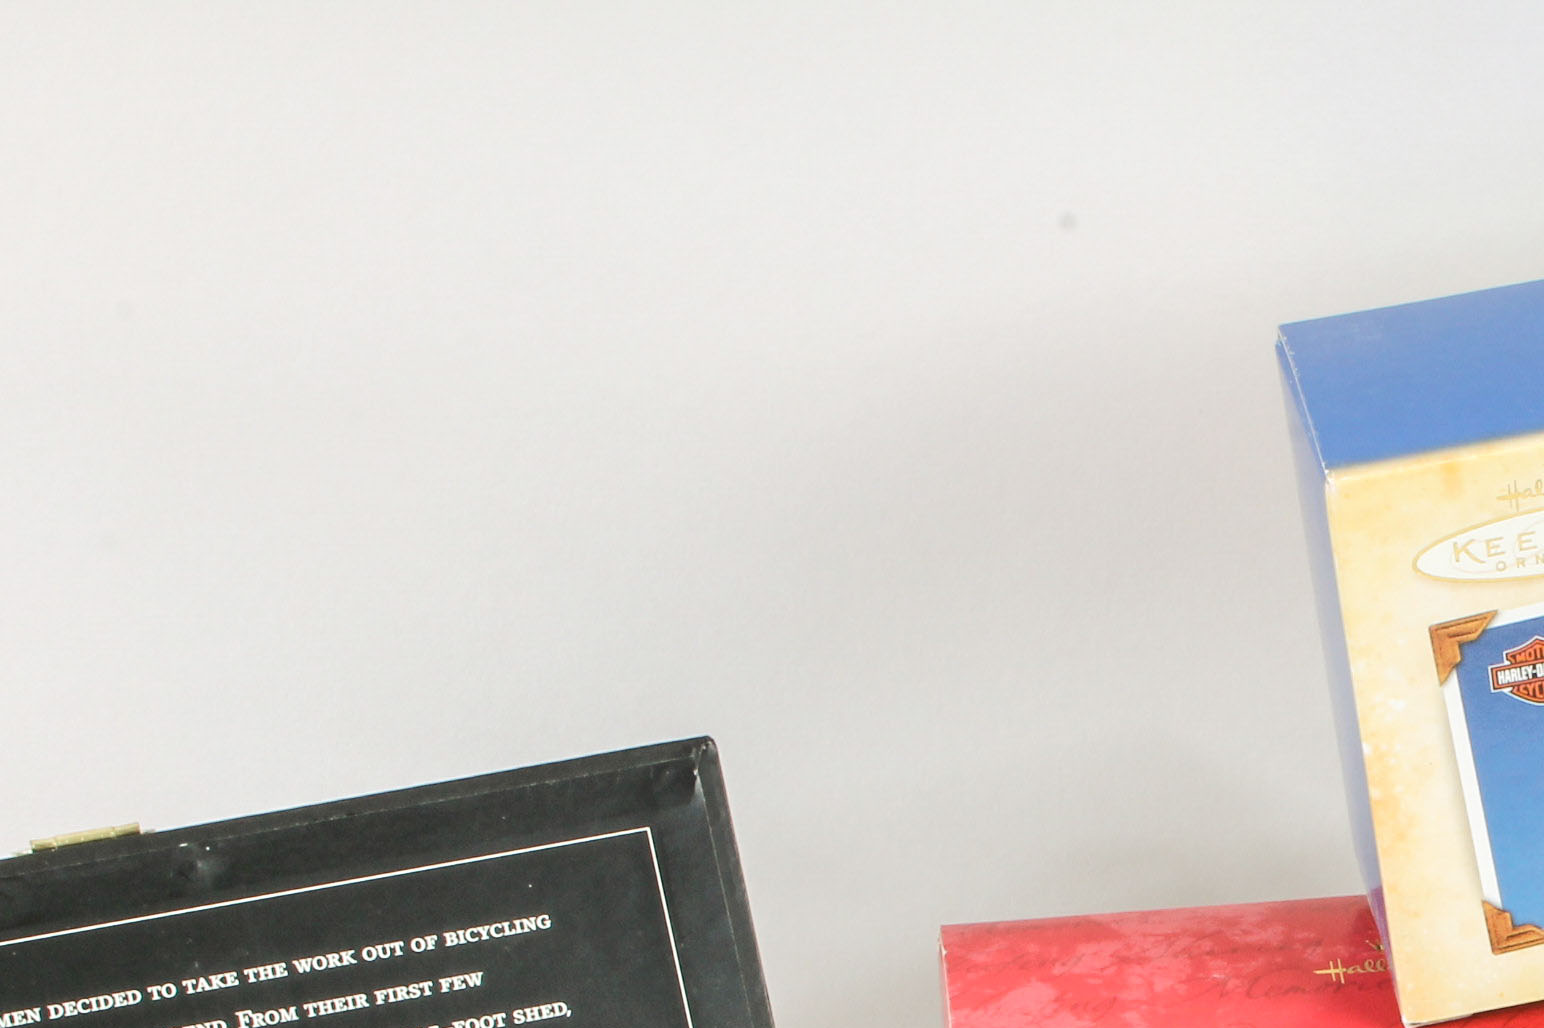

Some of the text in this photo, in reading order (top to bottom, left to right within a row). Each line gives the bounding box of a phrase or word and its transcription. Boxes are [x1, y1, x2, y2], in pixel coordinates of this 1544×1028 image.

[48, 989, 141, 1020] DECIDED
[148, 983, 176, 1000] TO
[183, 971, 239, 995] TAKE
[245, 963, 288, 982] THE
[293, 949, 357, 974] WORK
[362, 941, 404, 961] OUT
[411, 935, 437, 953] OF
[444, 914, 551, 947] BICYCLING
[304, 993, 369, 1018] THEIR
[375, 981, 433, 1005] FIRST
[440, 971, 483, 992] FEW
[513, 1001, 571, 1025] SHED,
